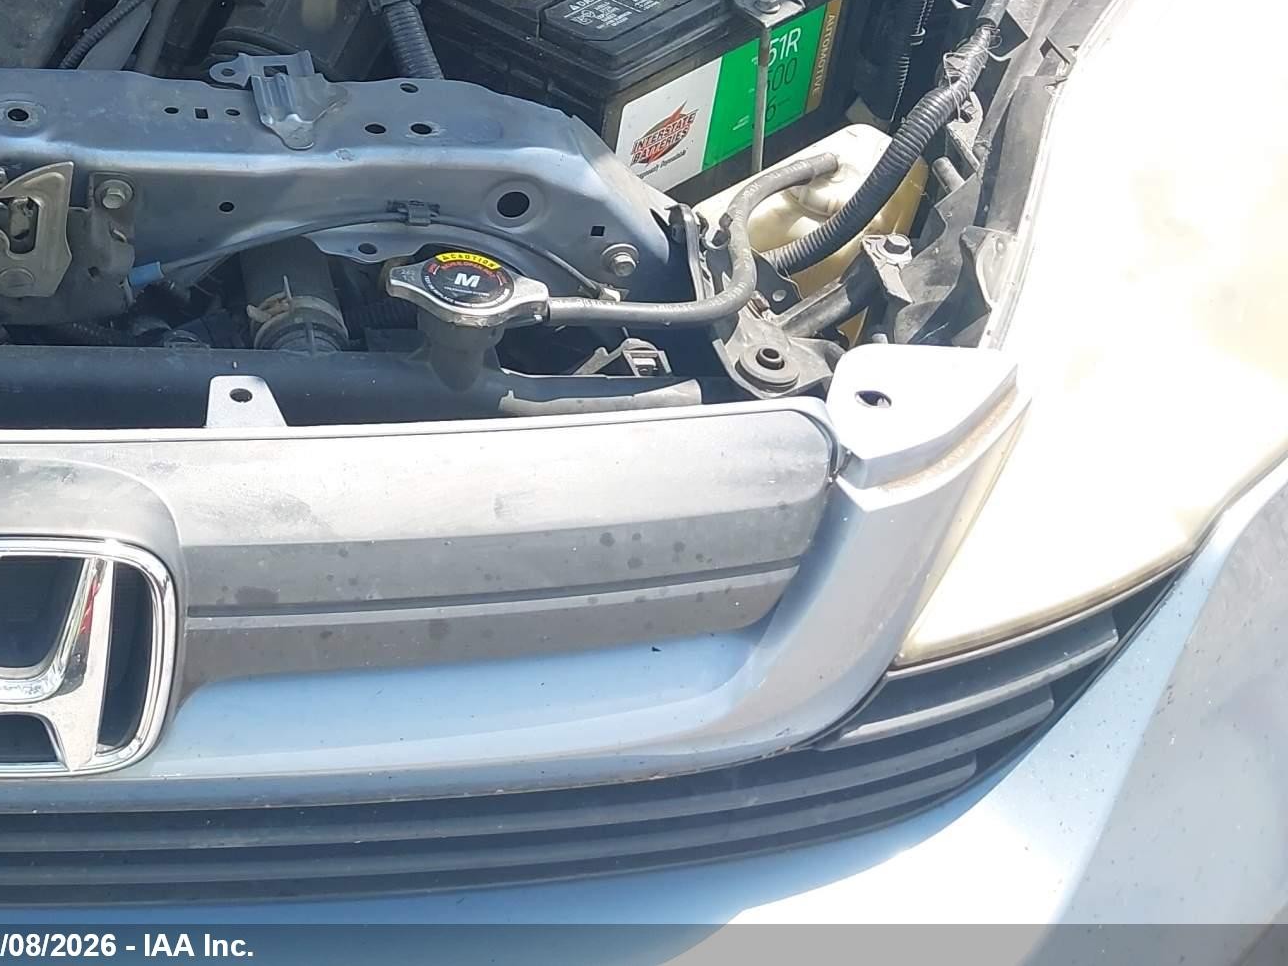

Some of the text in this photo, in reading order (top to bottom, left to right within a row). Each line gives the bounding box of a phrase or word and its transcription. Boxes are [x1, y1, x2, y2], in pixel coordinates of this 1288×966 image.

[811, 15, 835, 96] AUTOMOTIVE
[632, 113, 697, 151] INTERSTATE
[632, 127, 690, 164] BATTERIES
[450, 253, 497, 269] CAUTION
[454, 272, 480, 288] M
